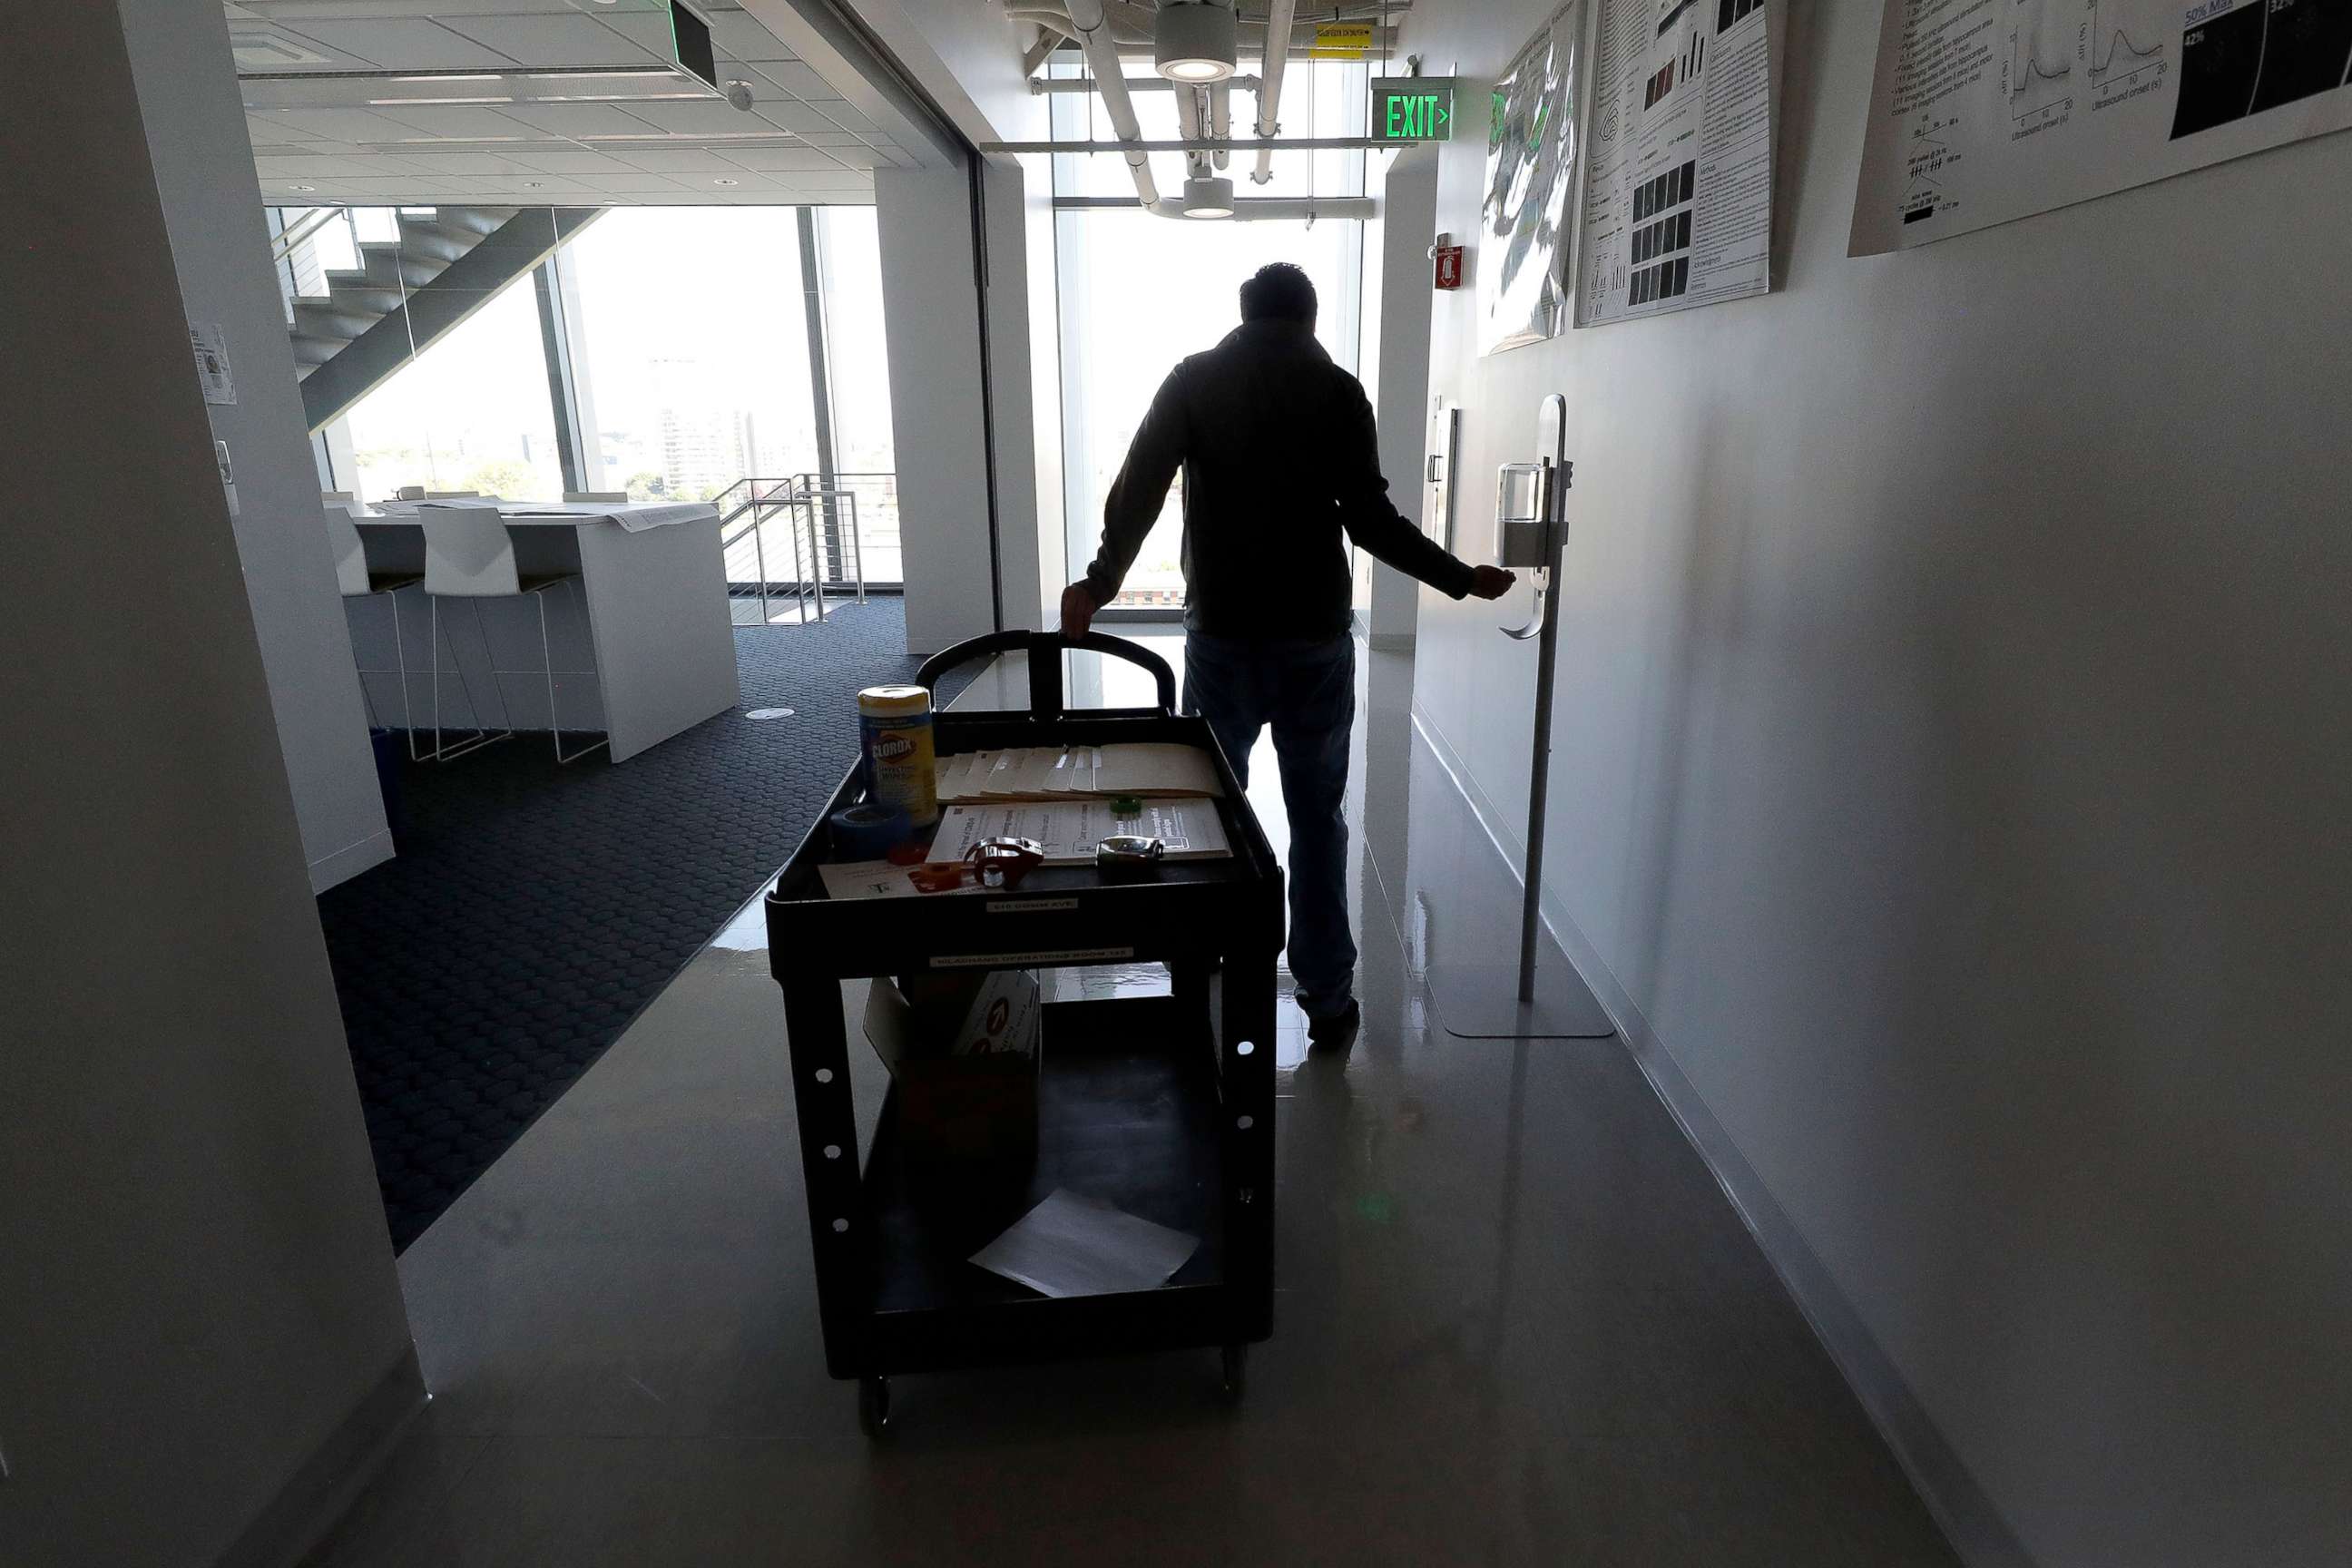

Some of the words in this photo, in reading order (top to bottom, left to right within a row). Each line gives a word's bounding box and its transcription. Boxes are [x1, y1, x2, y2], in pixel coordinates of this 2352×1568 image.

[2185, 6, 2206, 24] 50%
[2102, 85, 2108, 95] 0
[2129, 75, 2137, 85] 10
[2157, 63, 2167, 74] 20
[2092, 91, 2128, 111] Ultrasound
[2129, 83, 2150, 98] onset
[2151, 79, 2161, 92] (s)
[1387, 95, 1438, 138] EXIT
[2020, 119, 2025, 127] 0
[2064, 100, 2073, 110] 20
[2012, 122, 2042, 141] Ultrasound
[872, 736, 911, 759] CLOROX
